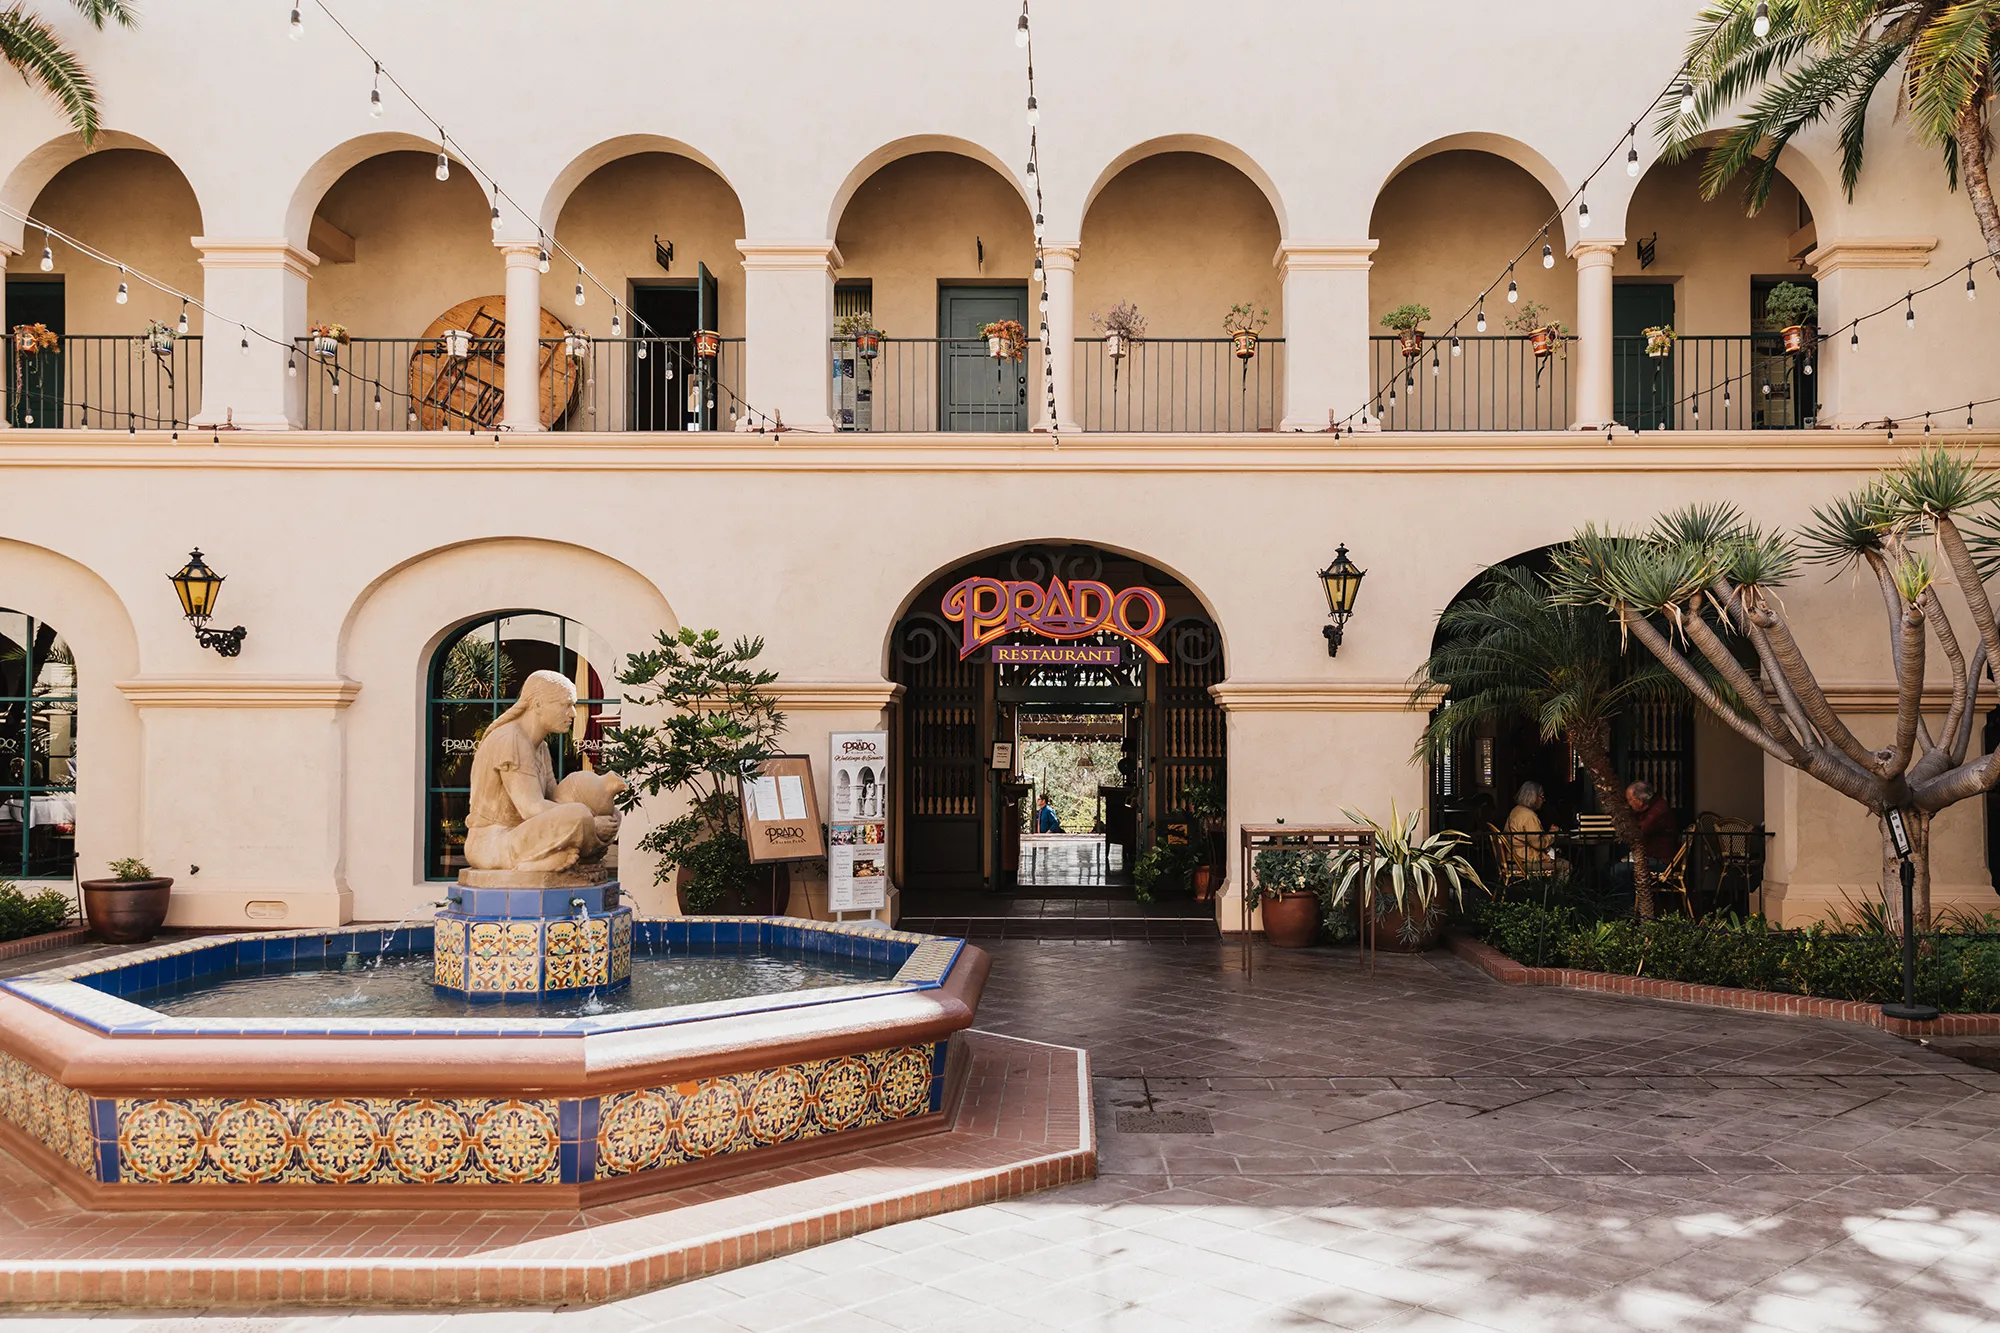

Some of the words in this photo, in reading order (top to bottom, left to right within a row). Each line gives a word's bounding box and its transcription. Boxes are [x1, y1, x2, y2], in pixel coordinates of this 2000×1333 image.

[941, 575, 1169, 663] PRADO
[999, 649, 1115, 662] RESTAURANT
[842, 741, 876, 754] PRADO
[765, 827, 806, 843] PRADO
